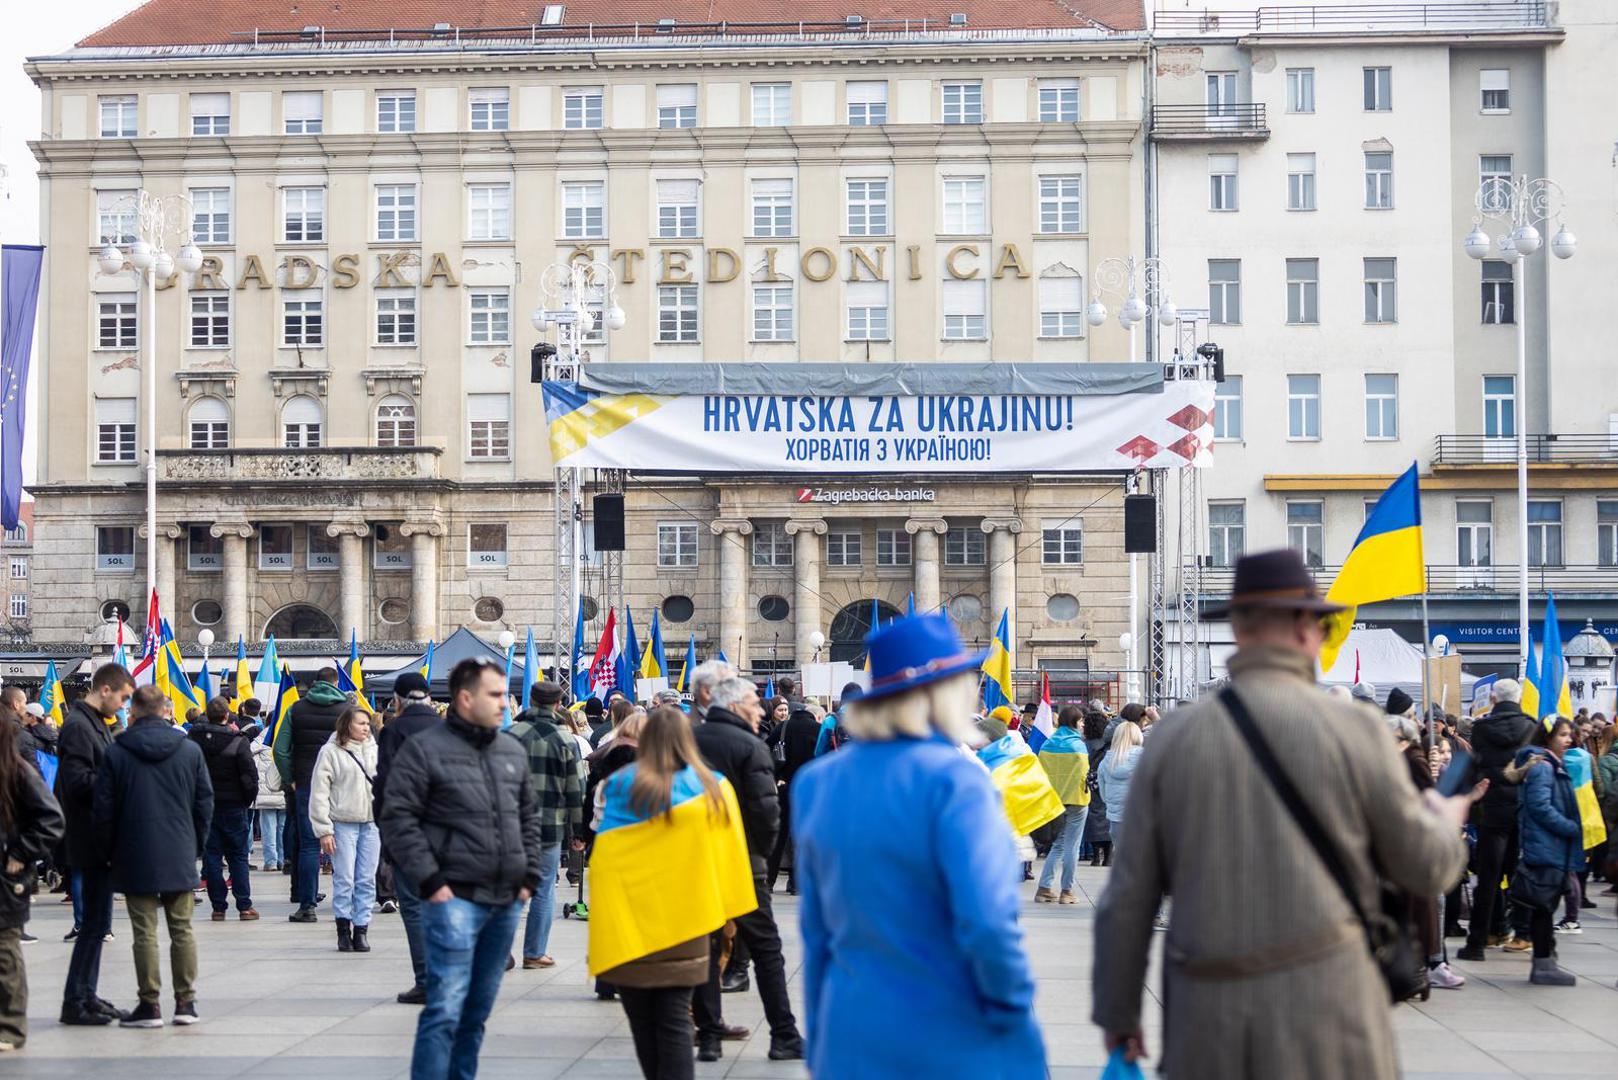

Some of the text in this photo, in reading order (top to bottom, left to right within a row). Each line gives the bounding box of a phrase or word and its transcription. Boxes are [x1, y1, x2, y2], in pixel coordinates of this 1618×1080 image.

[703, 395, 1073, 432] HRVATSKA ZA UKRAJINU!
[785, 435, 991, 461] ХОРВАТІЯ З УКРАЇНОЮ!
[815, 487, 935, 504] Zagrebačka banka
[107, 556, 124, 565] SOL
[200, 556, 216, 564] SOL
[268, 556, 285, 564] SOL
[317, 556, 333, 564] SOL
[386, 555, 404, 563] SOL
[1459, 627, 1493, 635] VISITOR
